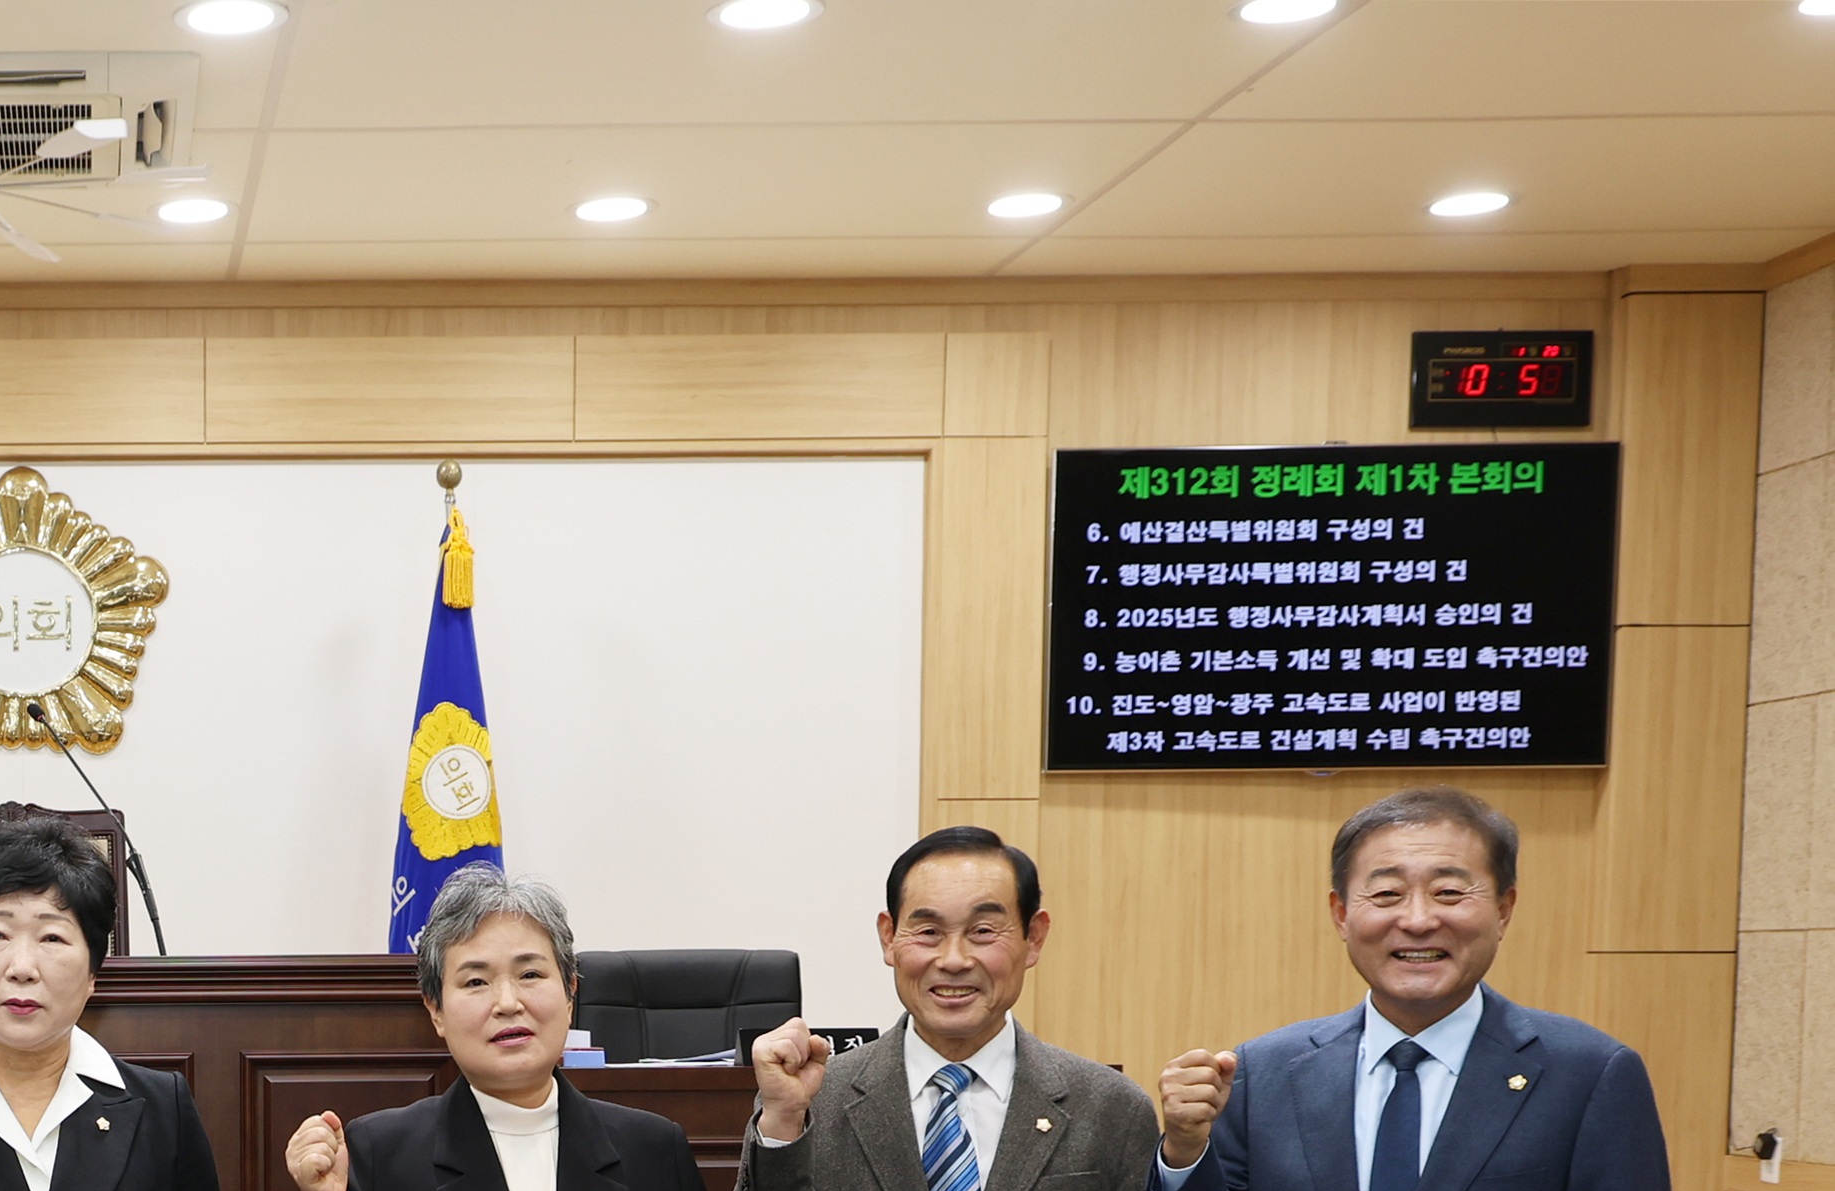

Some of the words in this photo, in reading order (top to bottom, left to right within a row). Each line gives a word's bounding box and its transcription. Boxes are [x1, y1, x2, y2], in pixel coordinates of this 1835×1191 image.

[1118, 465, 1240, 500] 제312회
[1250, 463, 1345, 498] 정례회
[1355, 462, 1441, 496] 제1차
[1448, 460, 1544, 495] 본회의
[1086, 522, 1110, 543] 6.
[1118, 518, 1318, 545] 예산결산특별위원회
[1325, 517, 1394, 542] 구성의
[1402, 517, 1425, 541] 건
[1085, 565, 1109, 585] 7.
[1118, 560, 1361, 587] 행정사무감사특별위원회
[1368, 559, 1437, 584] 구성의
[1445, 559, 1468, 582] 건
[1083, 608, 1107, 629] 8.
[1116, 606, 1219, 629] 2025년도
[1227, 603, 1427, 629] 행정사무감사계획서
[1434, 602, 1502, 627] 승인의
[1510, 602, 1533, 625] 건
[1082, 652, 1106, 672] 9.
[1114, 650, 1182, 674] 농어촌
[1189, 649, 1279, 673] 기본소득
[1286, 648, 1331, 672] 개선
[1339, 647, 1362, 671] 및
[1369, 647, 1415, 670] 확대
[1421, 646, 1468, 670] 도입
[1475, 645, 1589, 669] 촉구건의안
[1066, 695, 1102, 715] 10.
[1111, 692, 1275, 717] 진도~영암~광주
[1281, 691, 1372, 715] 고속도로
[1378, 690, 1446, 714] 사업이
[1454, 689, 1521, 713] 반영된
[1105, 730, 1166, 753] 제3차
[1172, 730, 1262, 753] 고속도로
[1269, 728, 1358, 751] 건설계획
[1365, 727, 1411, 751] 수립
[1418, 726, 1532, 750] 촉구건의안
[439, 757, 481, 811] 의회
